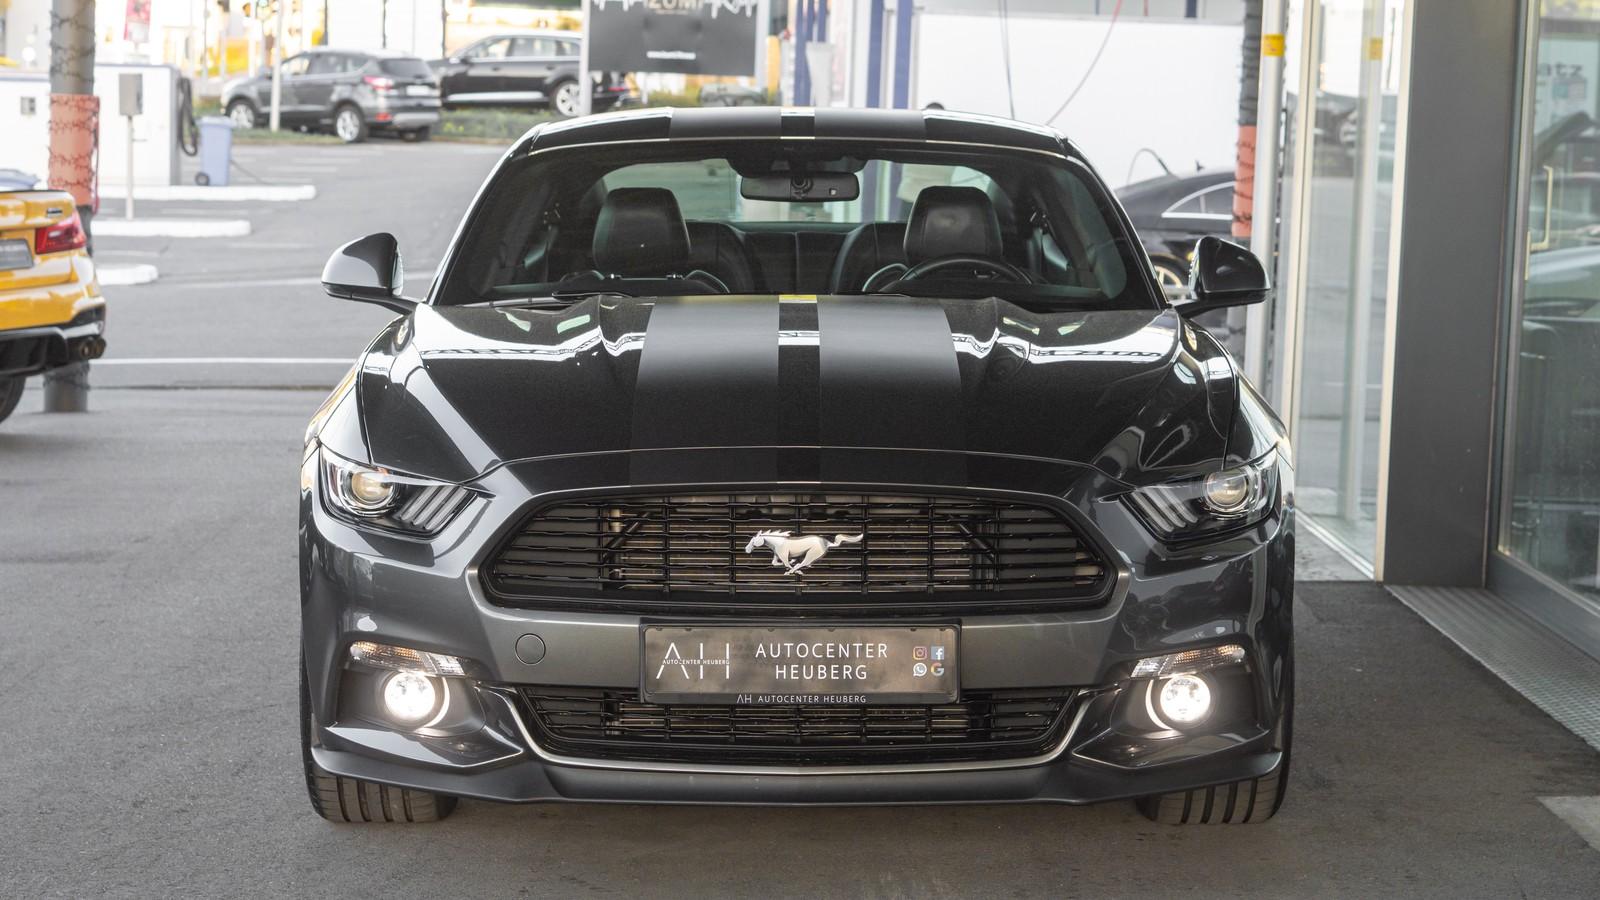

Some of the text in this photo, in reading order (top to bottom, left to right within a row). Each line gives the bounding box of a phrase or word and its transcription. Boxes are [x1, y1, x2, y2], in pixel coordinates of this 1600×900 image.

[755, 643, 888, 659] AUTOCENTER
[775, 664, 868, 680] HEUBERG
[736, 694, 867, 704] AH AUTOCENTER HEUBERG
